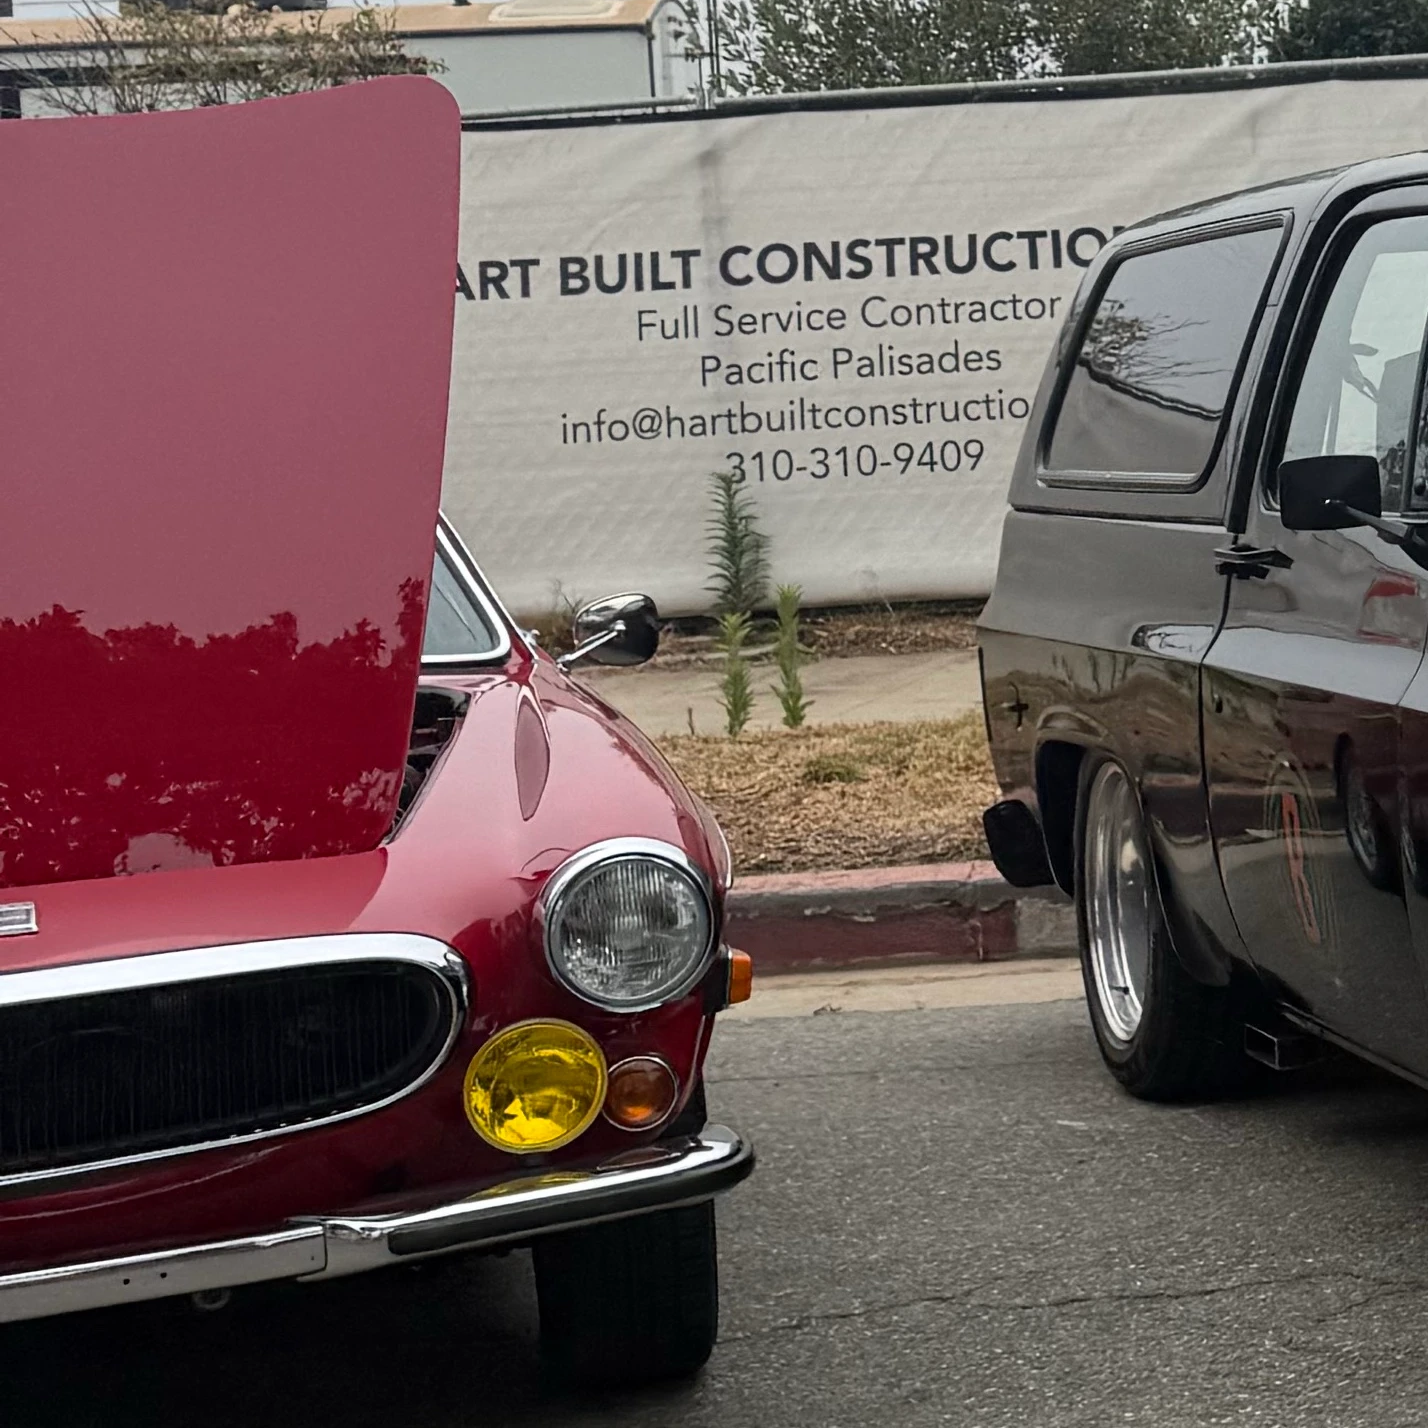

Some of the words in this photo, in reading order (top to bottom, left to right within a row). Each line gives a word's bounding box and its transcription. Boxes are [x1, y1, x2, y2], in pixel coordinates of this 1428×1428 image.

[559, 249, 701, 296] BUILT
[718, 225, 1125, 287] CONSTRUCTIO
[637, 304, 699, 342] Full
[713, 301, 847, 337] Service
[860, 293, 1062, 328] Contractor
[701, 348, 819, 387] Pacific
[832, 339, 1002, 380] Palisades
[561, 388, 1030, 445] info@hartbuiltconstructio
[725, 438, 985, 484] 310-310-9409
